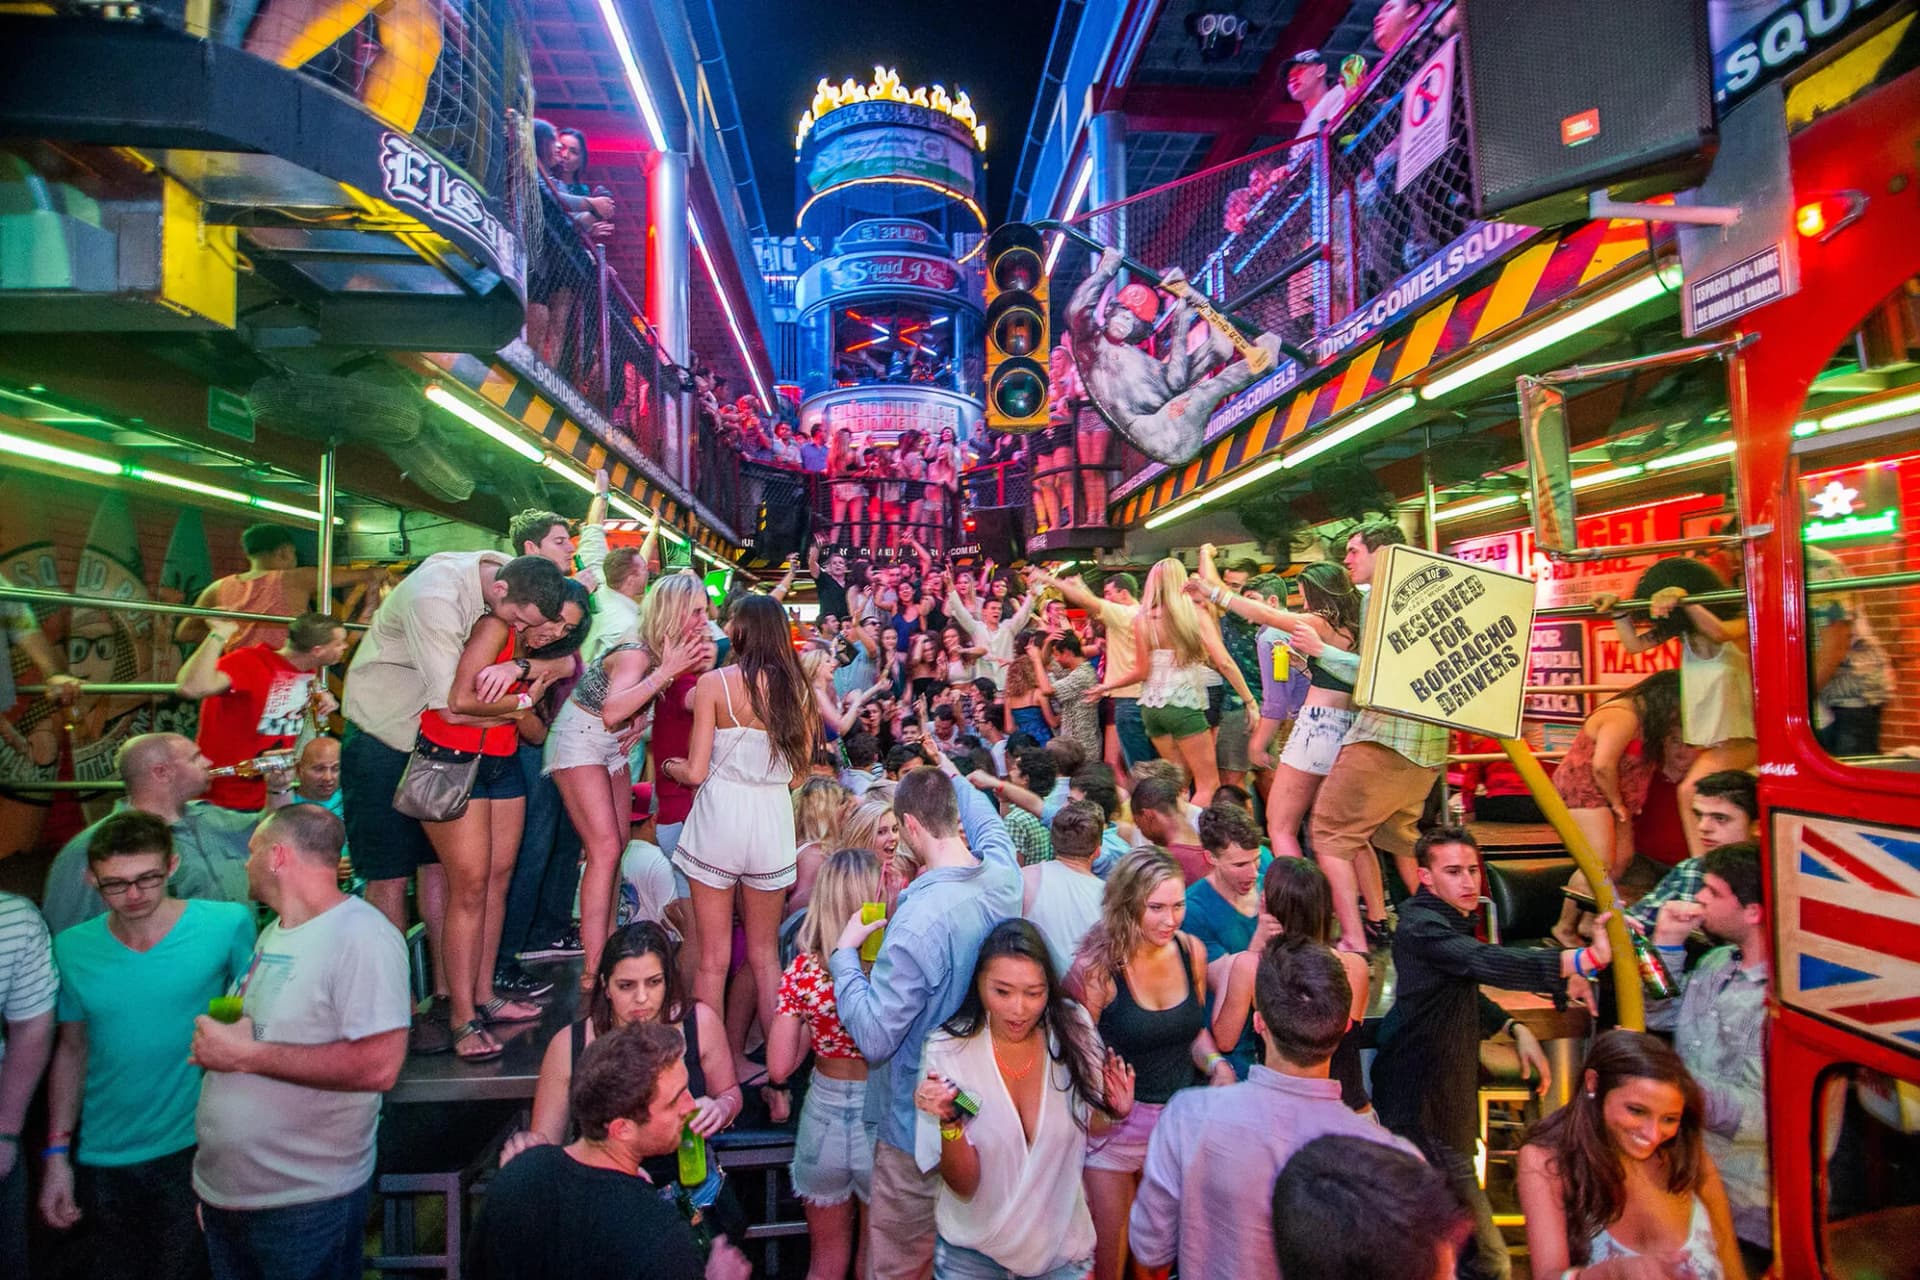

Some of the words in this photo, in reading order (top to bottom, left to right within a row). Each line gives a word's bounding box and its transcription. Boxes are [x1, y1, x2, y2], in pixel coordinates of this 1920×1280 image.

[1387, 574, 1486, 655] RESERVED
[1428, 615, 1474, 657] FOR
[1409, 614, 1519, 703] BORRACHO
[1434, 644, 1521, 717] DRIVERS
